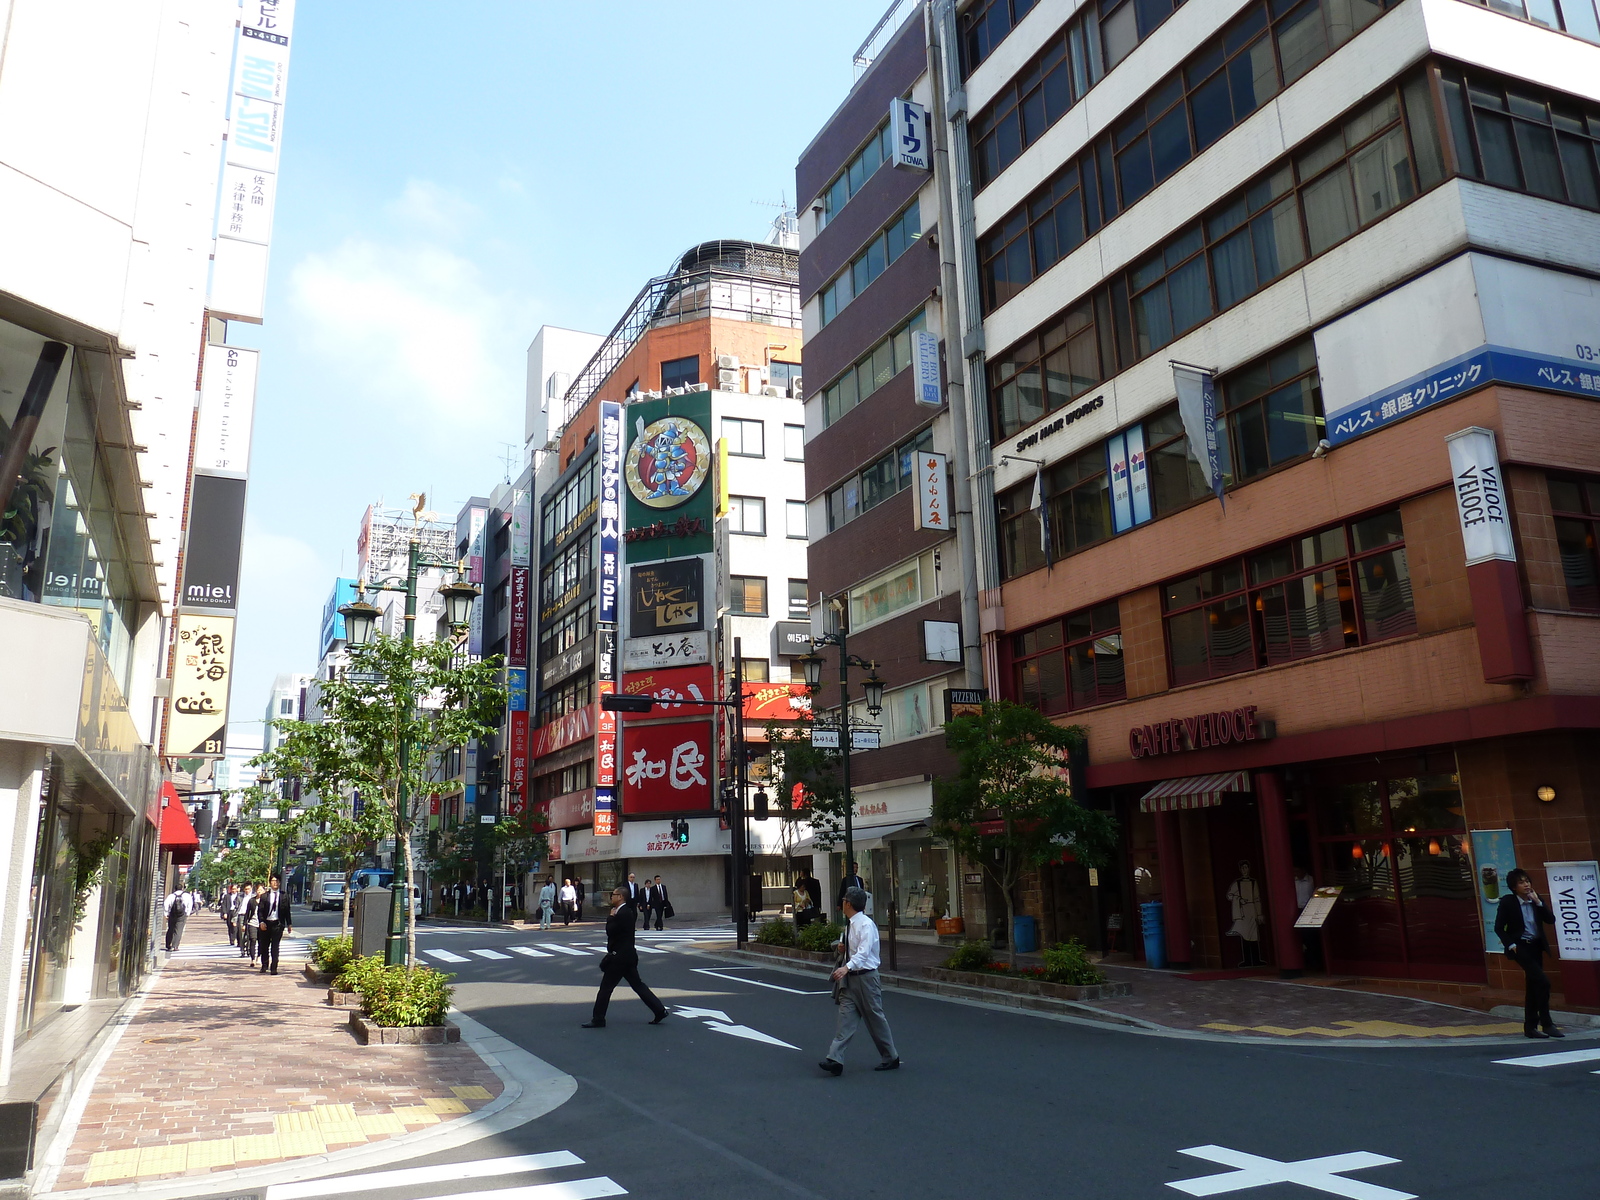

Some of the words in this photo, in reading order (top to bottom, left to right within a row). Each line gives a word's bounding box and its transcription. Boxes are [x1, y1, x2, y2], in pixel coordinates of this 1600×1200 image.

[903, 103, 921, 153] トーワ
[901, 153, 925, 167] TOWA
[230, 182, 246, 233] 法律事務所
[251, 175, 265, 206] 佐久間
[920, 333, 929, 382] GALLERY
[928, 334, 936, 357] ART
[1576, 344, 1600, 361] 03-
[930, 361, 938, 382] BOX
[1335, 363, 1482, 435] ペレス・銀座クリニック
[1016, 432, 1038, 453] SPIN
[1040, 418, 1064, 440] HAIR
[1065, 395, 1104, 425] WORKS
[1458, 465, 1485, 528] VELOCE
[1481, 466, 1503, 523] VELOCE
[187, 584, 232, 599] miel
[664, 603, 694, 623] しゃく
[951, 691, 981, 703] PIZZERIA
[205, 739, 221, 753] B1
[601, 723, 614, 731] 3F
[1183, 705, 1258, 750] VELOCE
[601, 775, 613, 783] 2F
[625, 740, 707, 790] 和民
[1559, 887, 1582, 936] VELOCE
[1585, 887, 1600, 935] VELOCE
